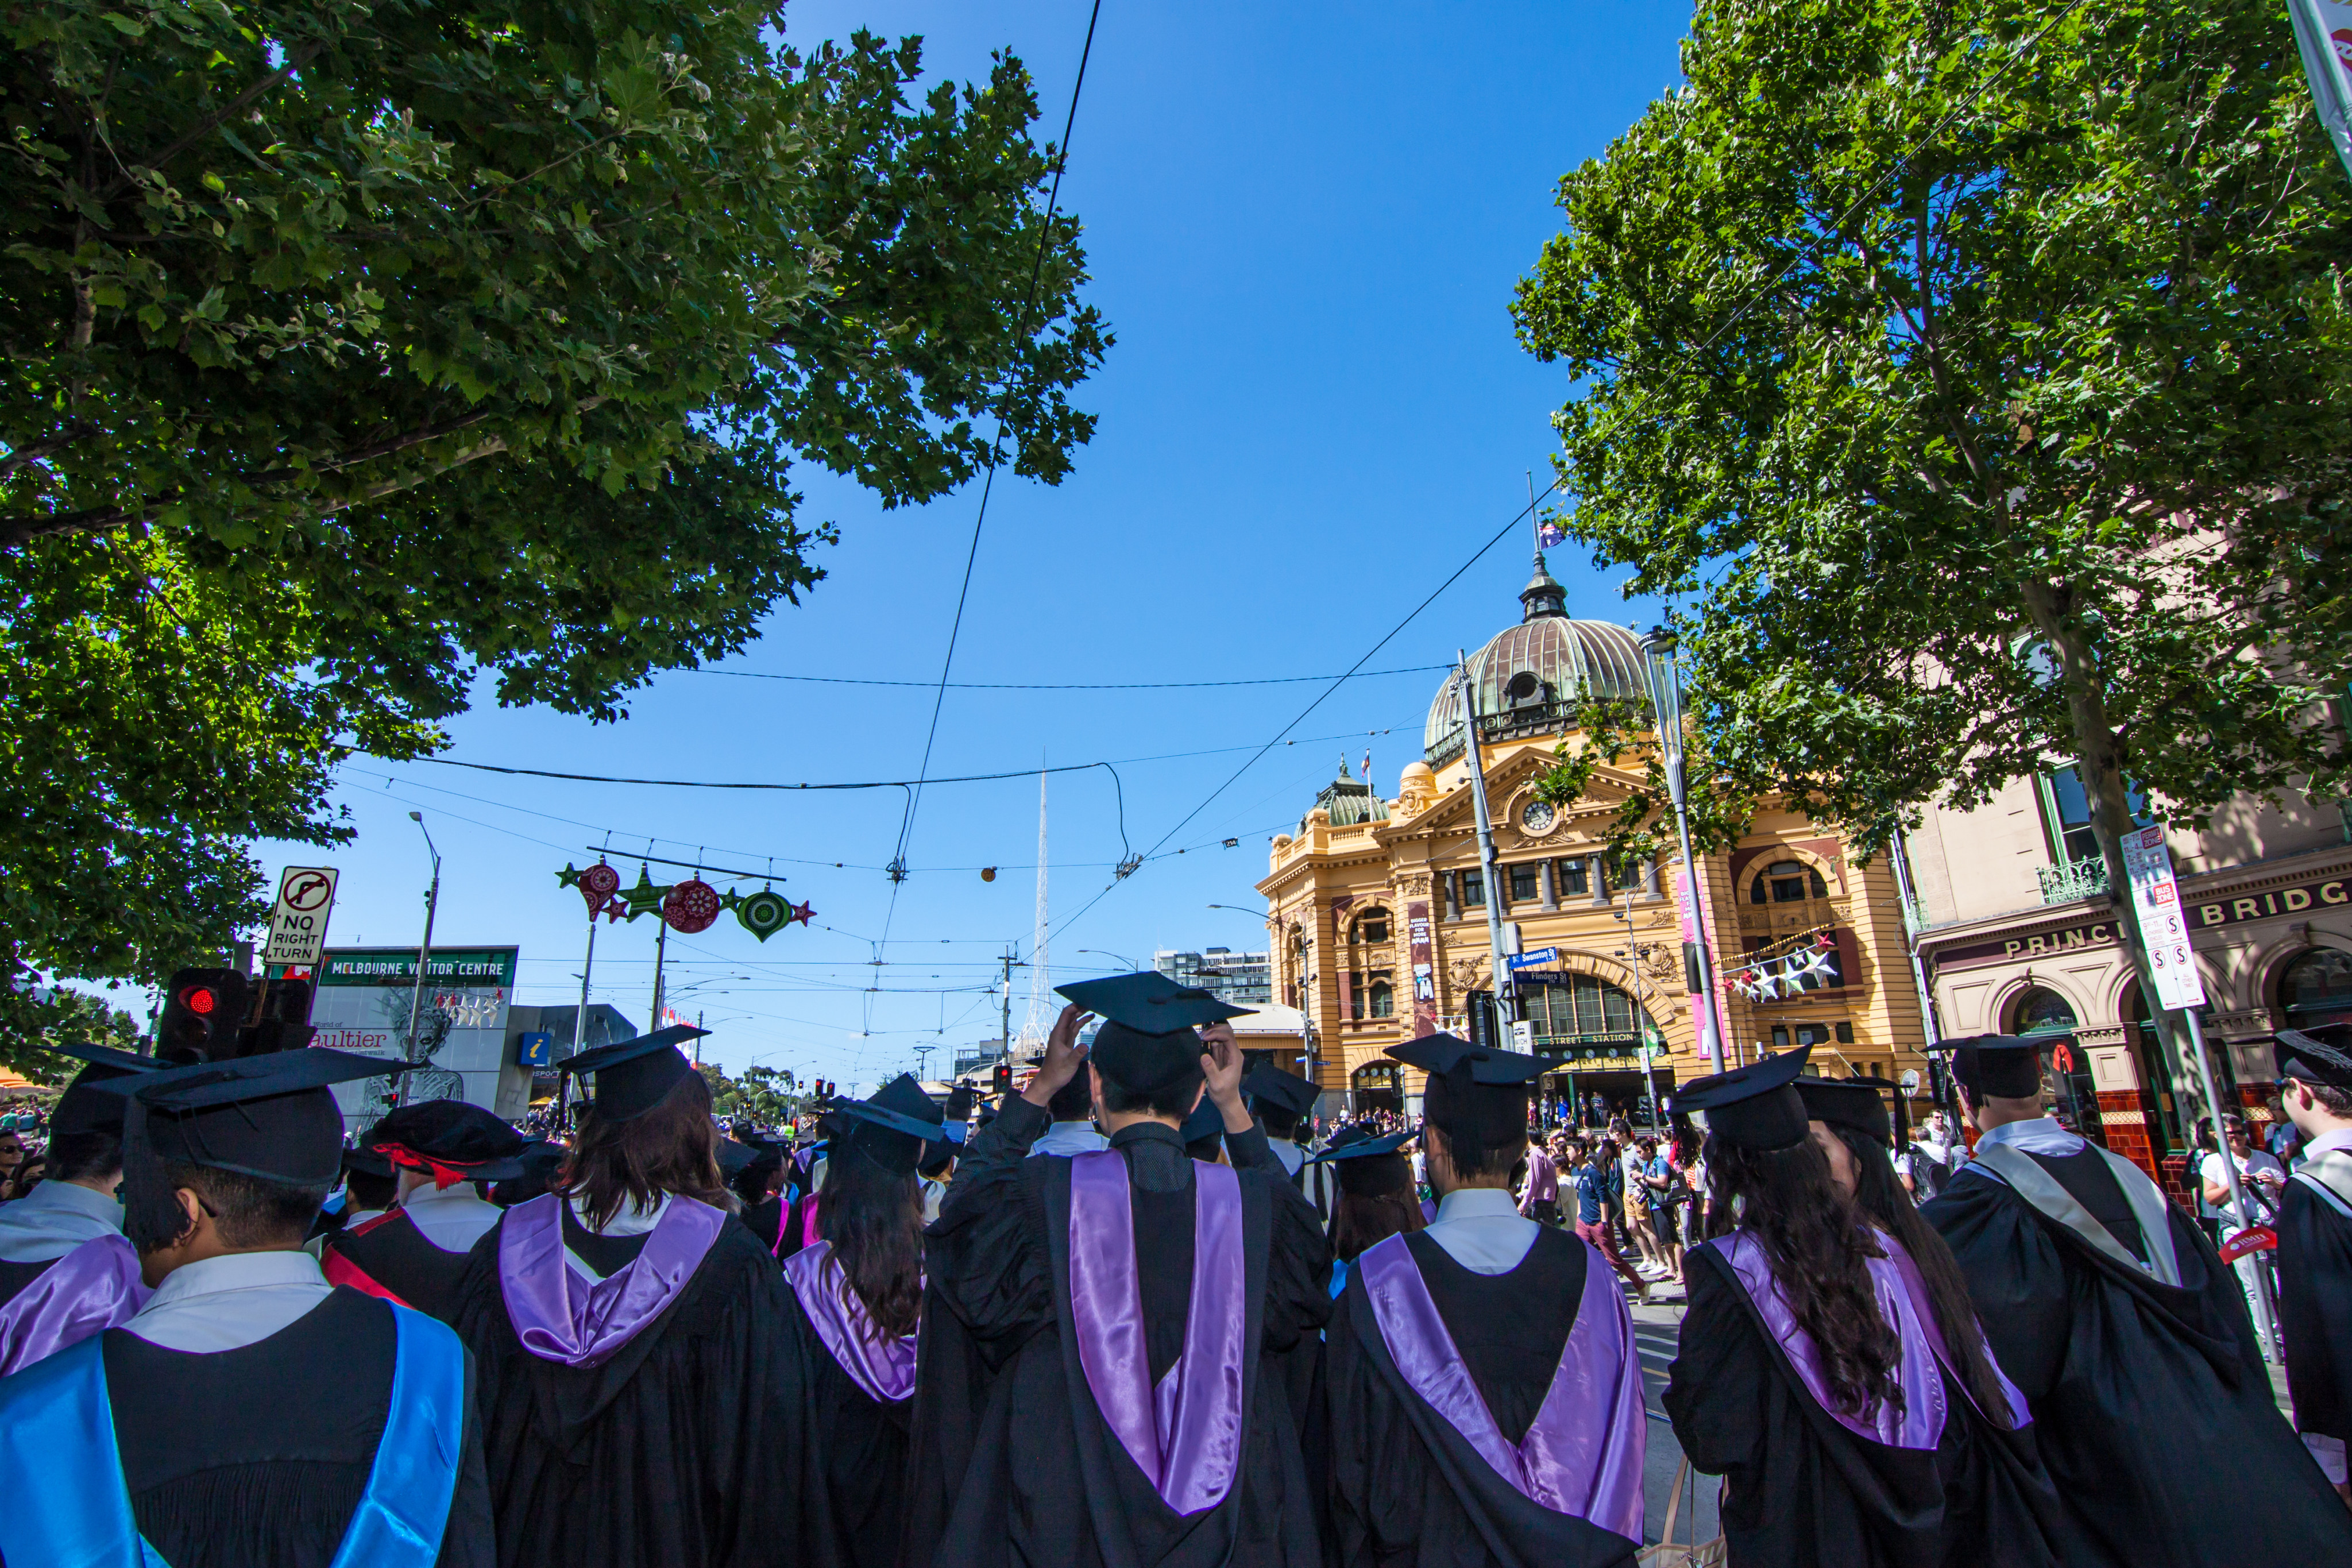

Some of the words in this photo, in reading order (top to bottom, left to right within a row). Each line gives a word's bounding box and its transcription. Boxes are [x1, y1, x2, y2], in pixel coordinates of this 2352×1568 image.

[2142, 828, 2159, 839] PERMIT
[2144, 836, 2161, 847] ZONE
[2155, 885, 2171, 895] BUS
[2156, 892, 2173, 903] ZONE
[2200, 882, 2349, 925] BRIDG
[284, 915, 314, 930] NO
[275, 933, 319, 944] RIGHT
[273, 948, 312, 959] TURN
[1522, 951, 1547, 962] Swanston
[1548, 948, 1554, 957] St
[408, 963, 453, 975] VIITOR
[459, 963, 504, 975] CENTRE
[1550, 1036, 1582, 1045] STREET
[1593, 1034, 1633, 1043] STATION
[1547, 1078, 1552, 1088] 5
[2238, 1234, 2266, 1245] RMIT
